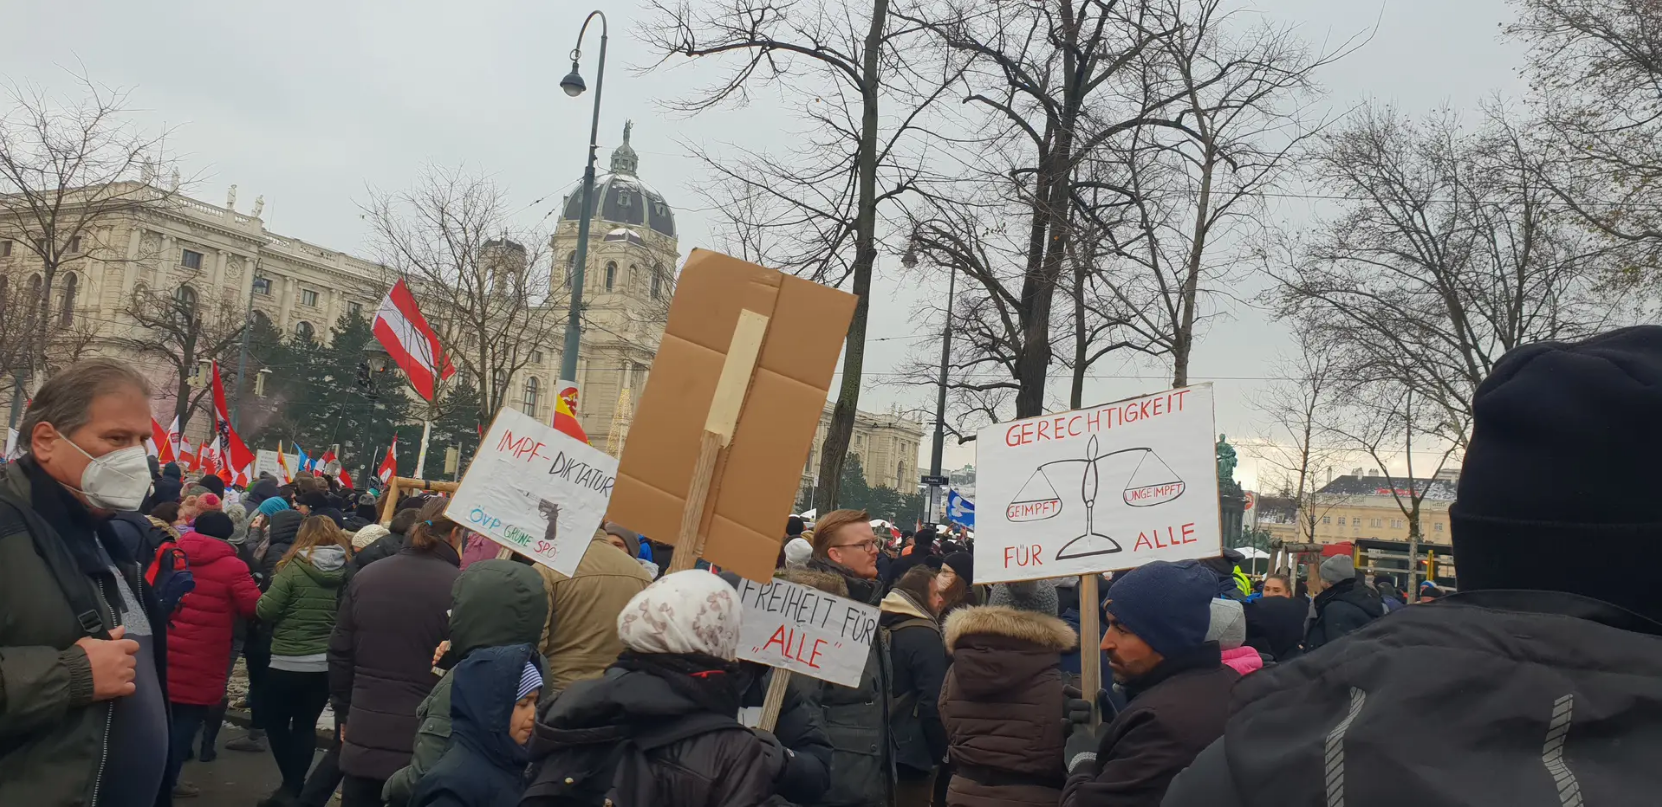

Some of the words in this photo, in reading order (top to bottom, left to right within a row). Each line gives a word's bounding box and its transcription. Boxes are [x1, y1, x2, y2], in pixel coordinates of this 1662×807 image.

[1005, 389, 1190, 447] GERECHTIGKEIT
[1007, 500, 1058, 518] GEIMPFT
[1124, 483, 1182, 502] UNGEIMPFT
[469, 504, 502, 530] ÖVP
[533, 540, 559, 559] SPÖ
[1004, 543, 1043, 568] FÜR
[1133, 522, 1197, 552] ALLE
[741, 579, 836, 628] FREIHEIT
[841, 607, 876, 646] FÜR
